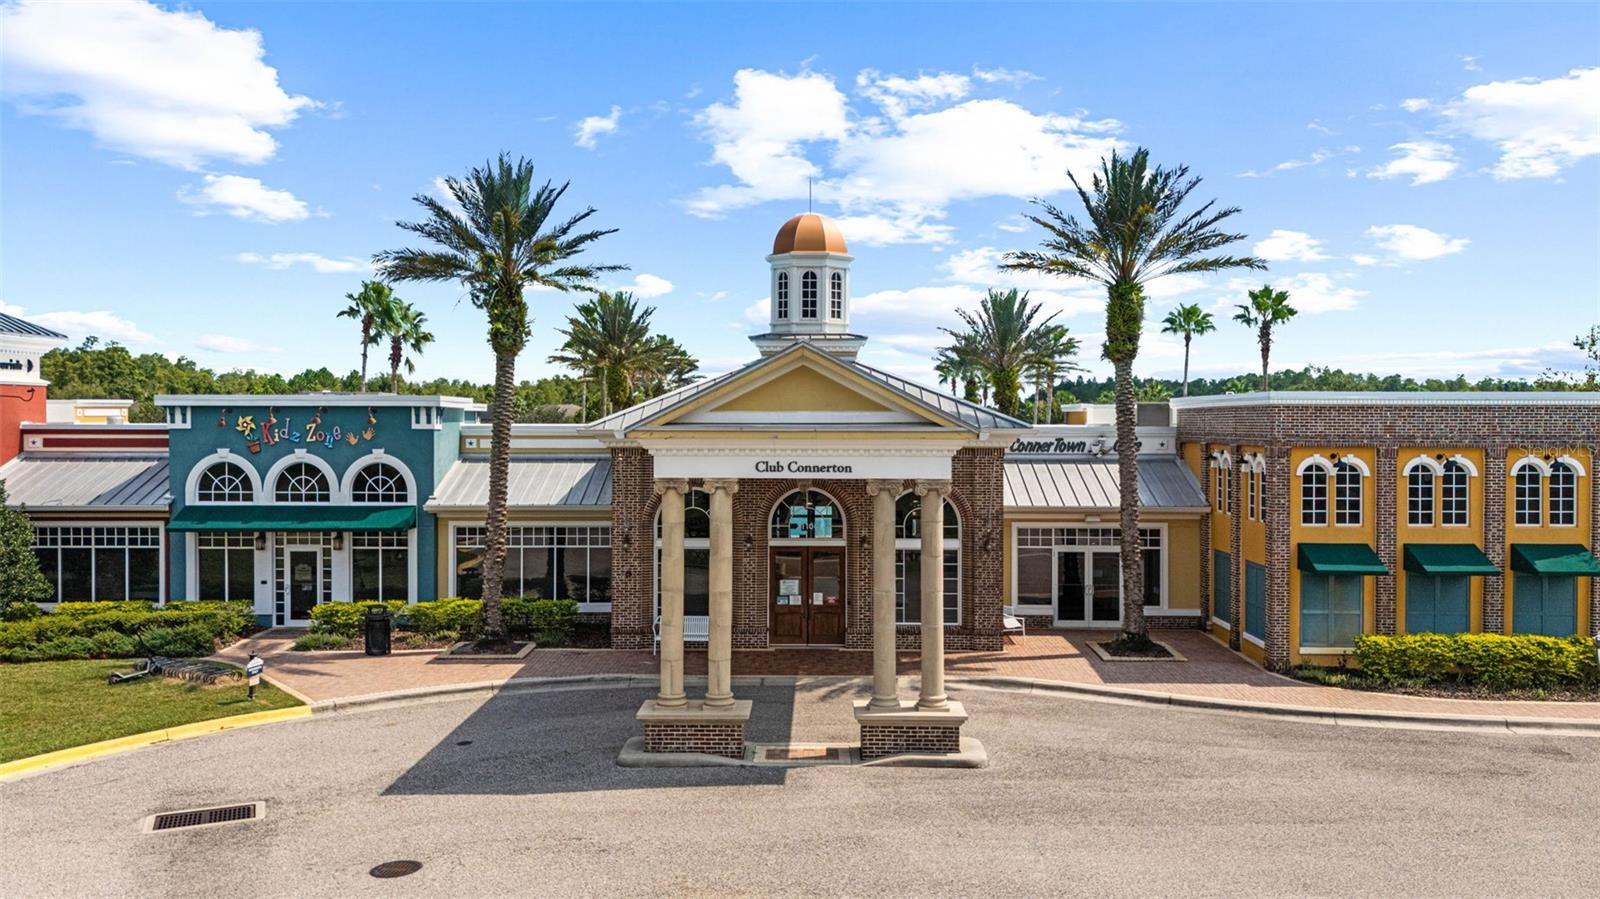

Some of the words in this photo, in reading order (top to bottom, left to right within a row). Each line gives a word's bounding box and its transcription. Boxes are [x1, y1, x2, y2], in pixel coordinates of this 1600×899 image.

[260, 417, 301, 445] Kidz
[306, 423, 341, 448] Zone
[755, 461, 784, 473] Club
[787, 461, 853, 473] Connerton
